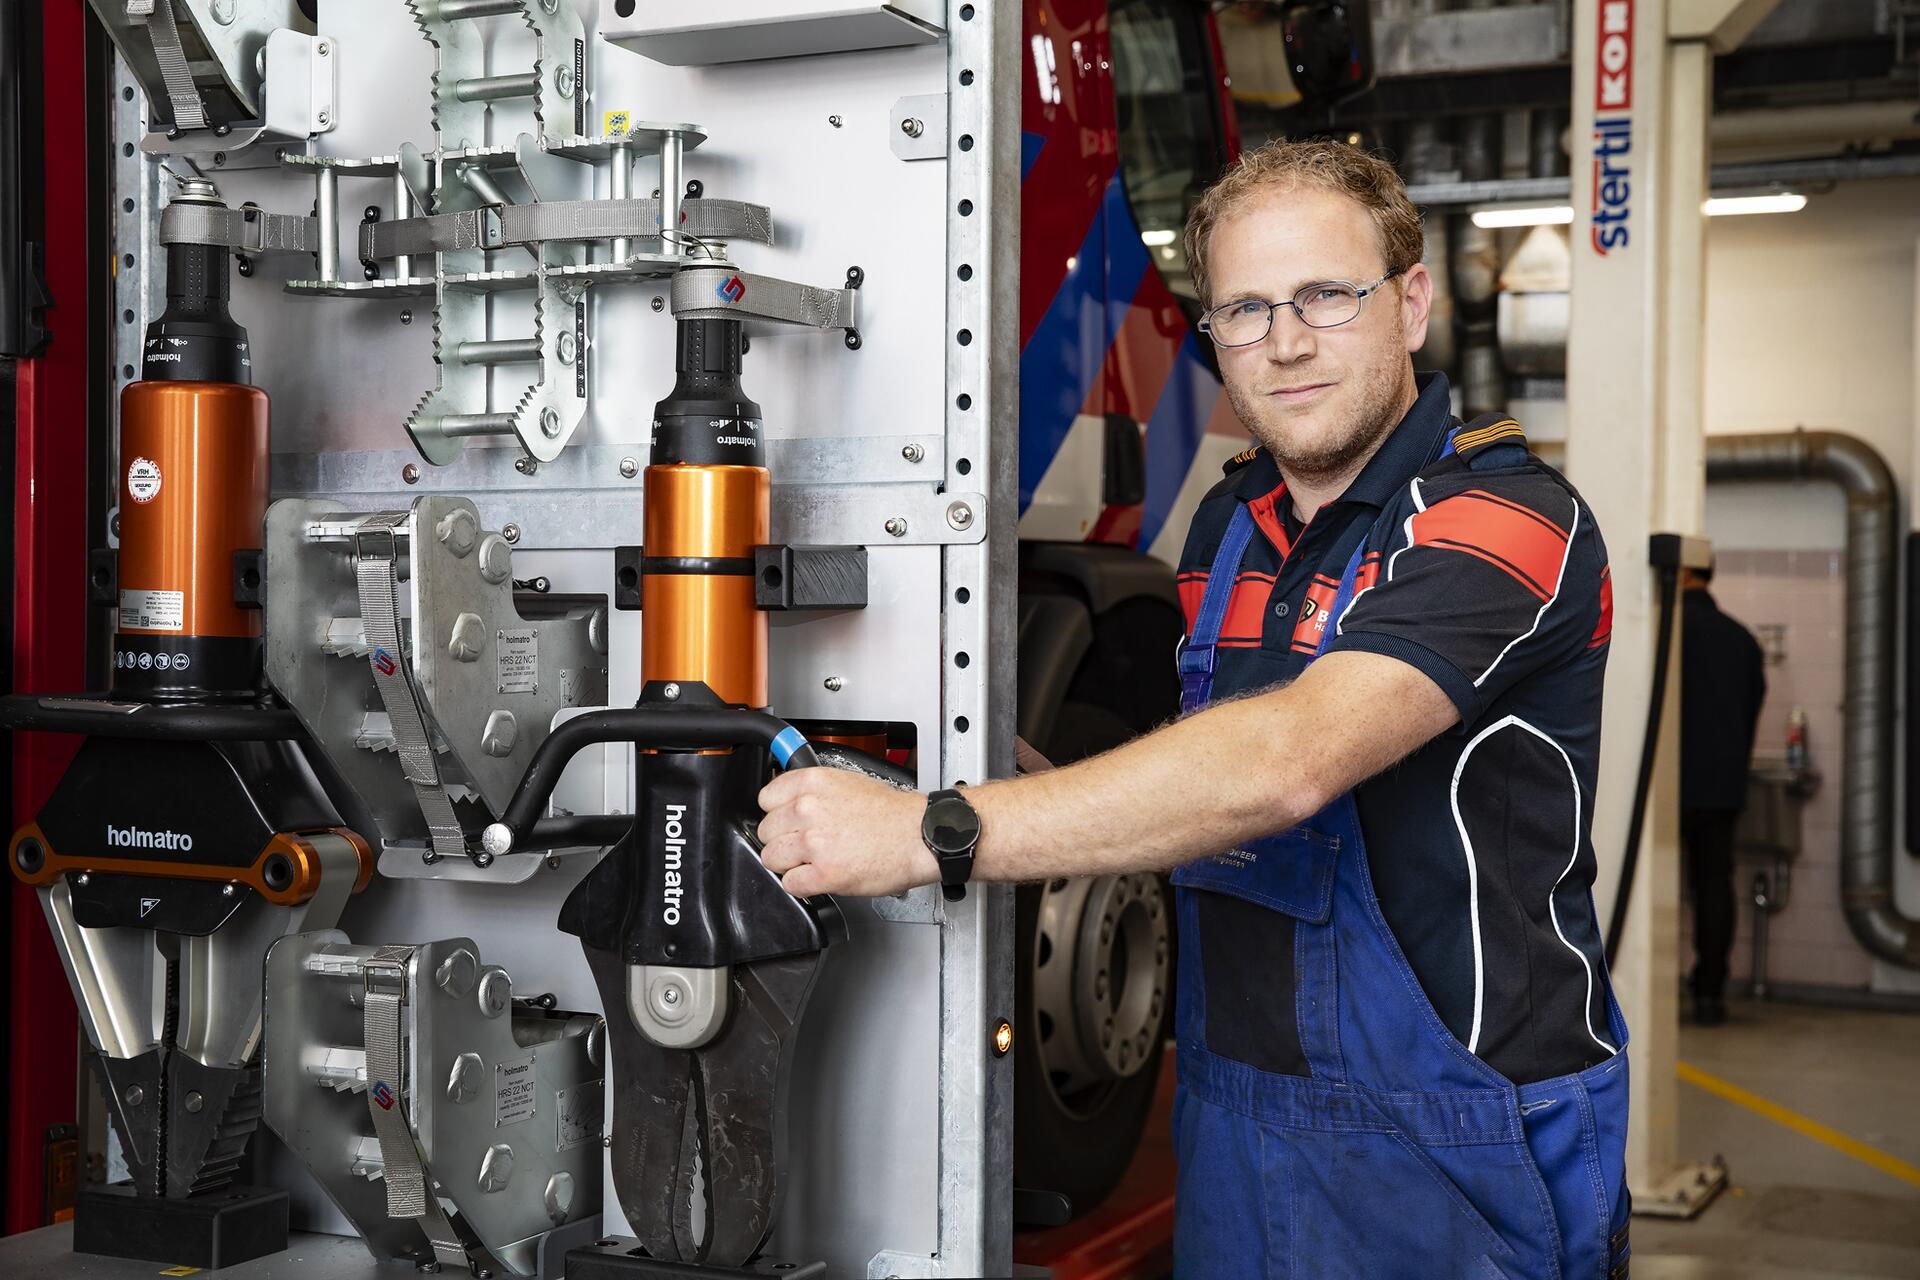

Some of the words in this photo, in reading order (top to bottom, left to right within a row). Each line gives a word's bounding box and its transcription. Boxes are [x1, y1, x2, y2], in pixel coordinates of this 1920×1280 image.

[1592, 118, 1632, 250] stertil
[147, 354, 181, 363] holmatro
[716, 436, 756, 448] holmatro
[1317, 609, 1329, 622] B
[500, 656, 513, 664] HRS
[515, 656, 522, 664] 22
[524, 655, 536, 664] NCT
[107, 825, 193, 851] holmatro
[664, 804, 686, 926] holmatro
[504, 1064, 529, 1076] holmatro
[498, 1088, 512, 1099] HRS
[513, 1086, 520, 1095] 22
[521, 1082, 535, 1093] NCT
